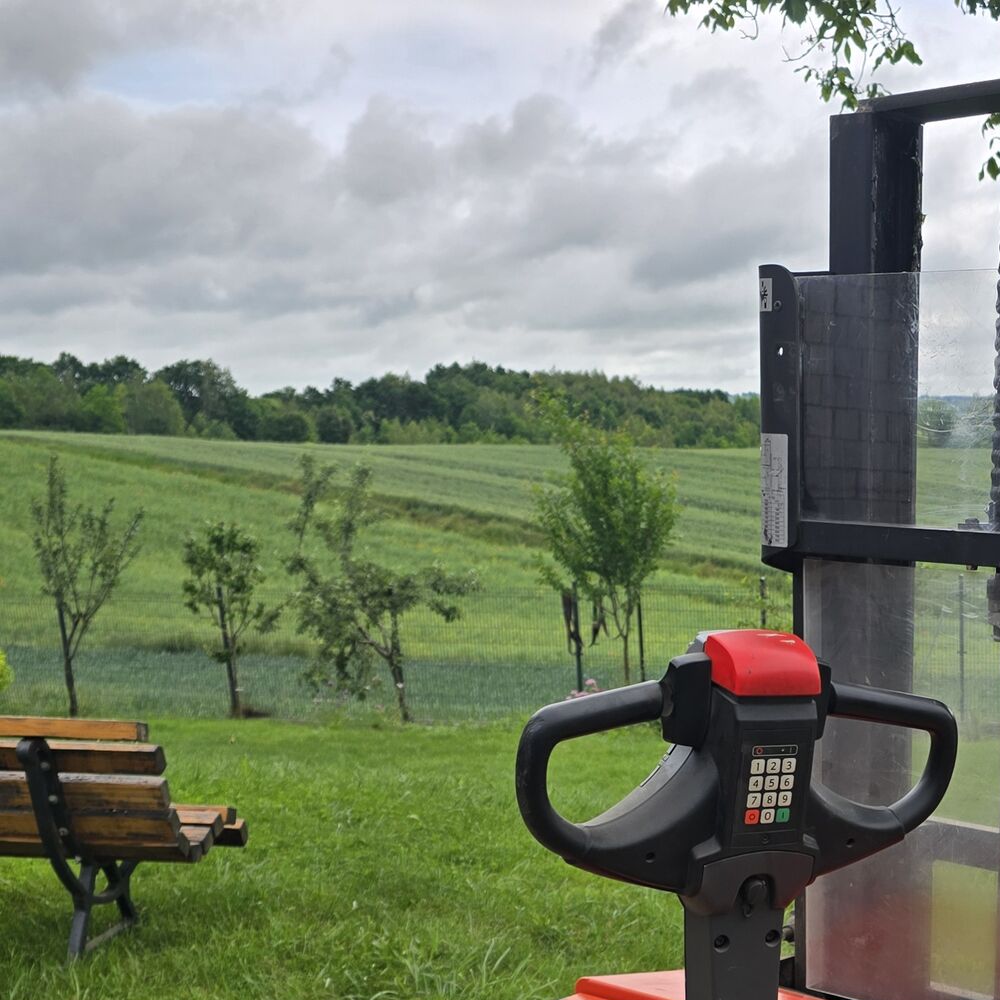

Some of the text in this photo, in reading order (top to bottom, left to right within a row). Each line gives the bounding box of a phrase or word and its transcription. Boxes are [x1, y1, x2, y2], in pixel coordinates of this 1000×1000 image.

[756, 761, 792, 772] 1 2 3
[753, 778, 790, 788] 4 5 6
[752, 795, 788, 805] 7 8 9
[764, 812, 771, 821] 0
